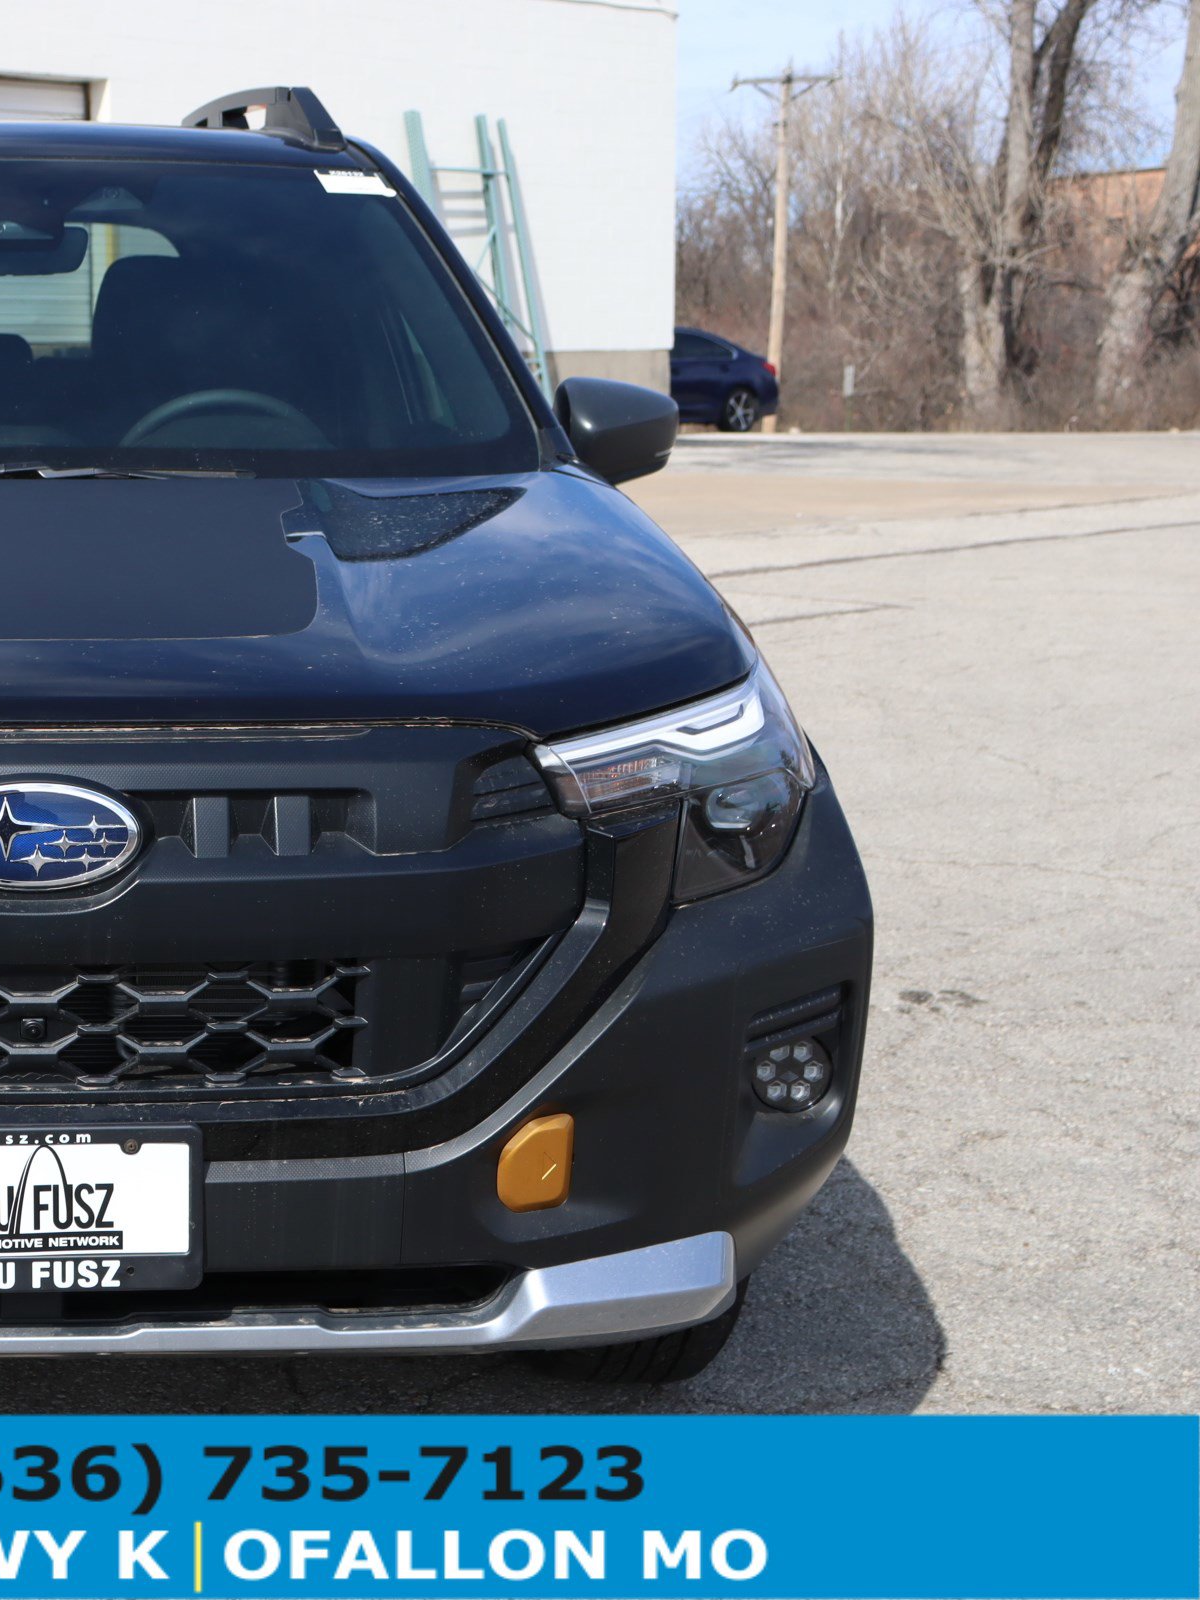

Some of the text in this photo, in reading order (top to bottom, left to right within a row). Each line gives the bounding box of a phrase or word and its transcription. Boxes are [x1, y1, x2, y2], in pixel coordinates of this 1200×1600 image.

[33, 1183, 114, 1231] FUSZ
[48, 1235, 120, 1248] NETWORK
[31, 1259, 121, 1289] FUSZ
